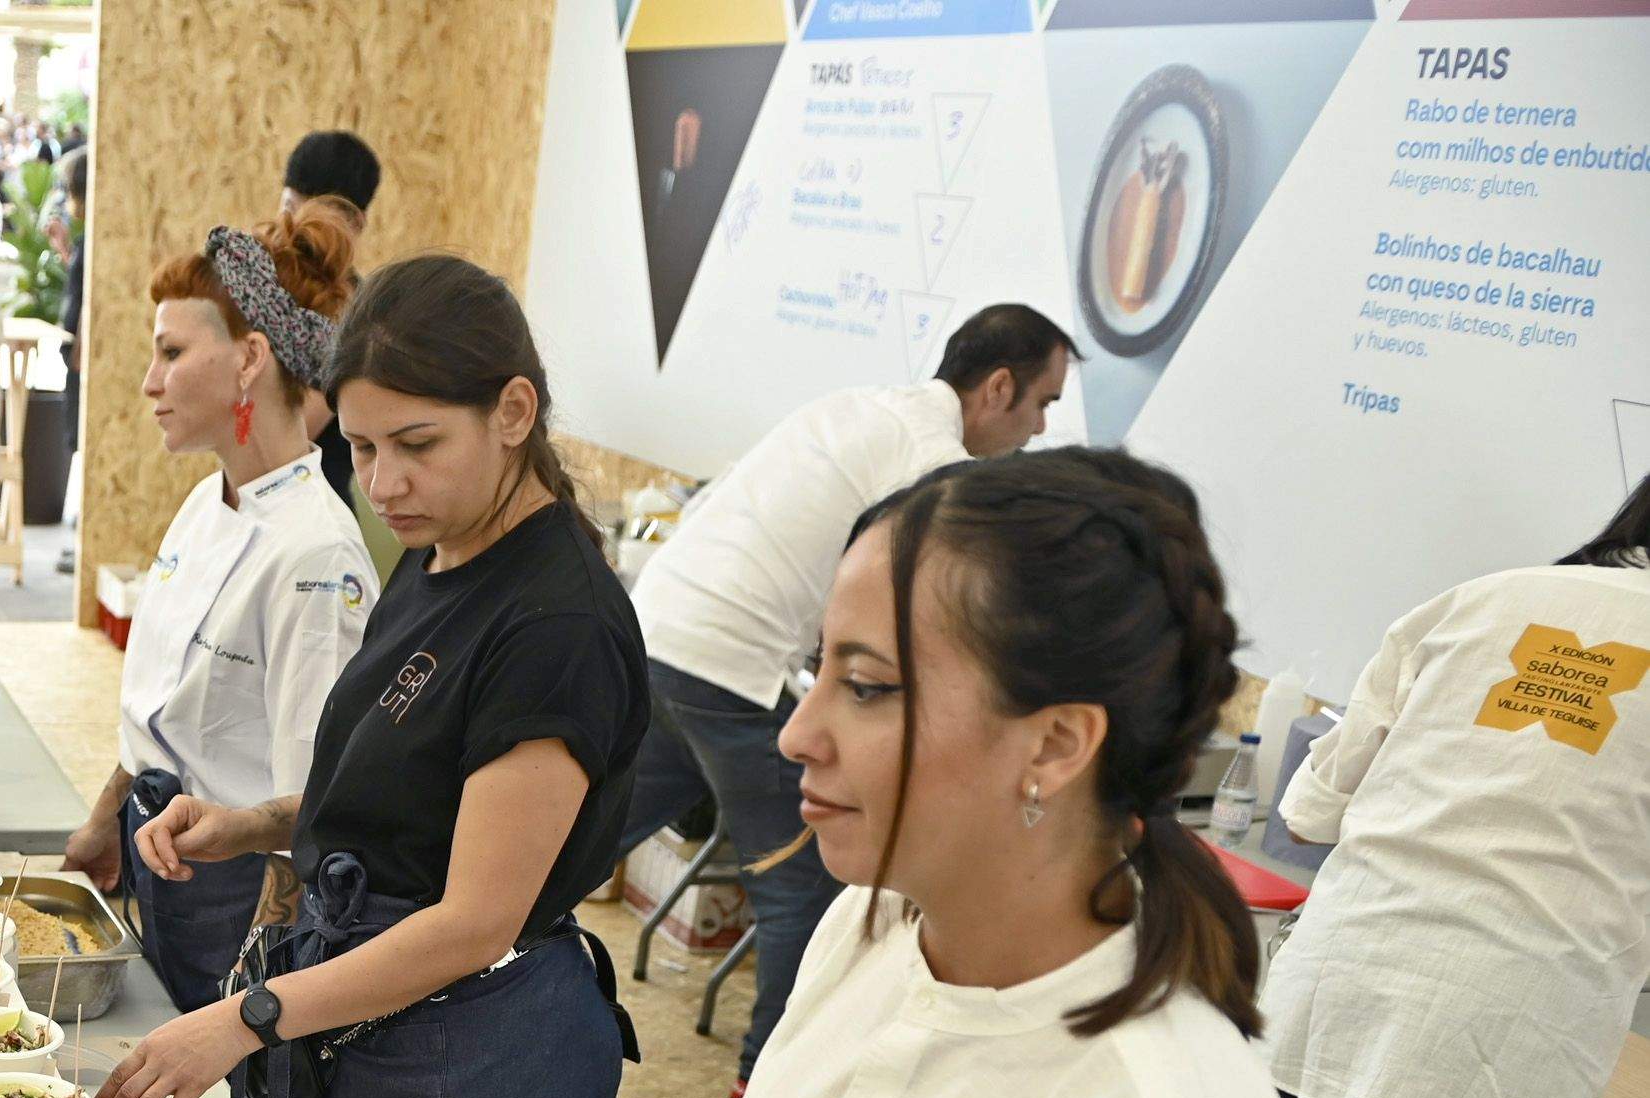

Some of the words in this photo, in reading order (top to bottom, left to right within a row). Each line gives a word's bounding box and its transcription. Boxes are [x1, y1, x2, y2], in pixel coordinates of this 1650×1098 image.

[809, 62, 853, 86] TAPAS
[1417, 46, 1511, 80] TAPAS
[1404, 98, 1457, 123] Rabo
[1462, 99, 1490, 124] de
[1494, 102, 1577, 128] ternera
[1397, 139, 1441, 160] com
[1445, 137, 1514, 164] milhos
[1520, 140, 1549, 165] de
[1388, 169, 1476, 195] Alergenos:
[1479, 173, 1539, 199] gluten.
[1466, 240, 1493, 266] de
[1496, 242, 1602, 278] bacalhau
[1366, 272, 1404, 293] con
[1407, 276, 1470, 301] queso
[1474, 279, 1502, 305] de
[1506, 283, 1525, 308] la
[1530, 287, 1596, 317] sierra
[1359, 300, 1444, 329] Alergenos:
[1447, 310, 1515, 342] lácteos,
[1518, 321, 1578, 348] gluten
[1353, 332, 1363, 351] y
[1367, 330, 1428, 357] huevos.
[1342, 382, 1401, 414] Tripas
[1548, 644, 1559, 654] X
[1561, 647, 1616, 666] EDICIÓN
[1526, 659, 1609, 688] saborea
[1513, 680, 1594, 711] FESTIVAL
[1497, 698, 1530, 713] VILLA
[1530, 705, 1548, 717] DE
[1549, 709, 1602, 732] TEGUISE
